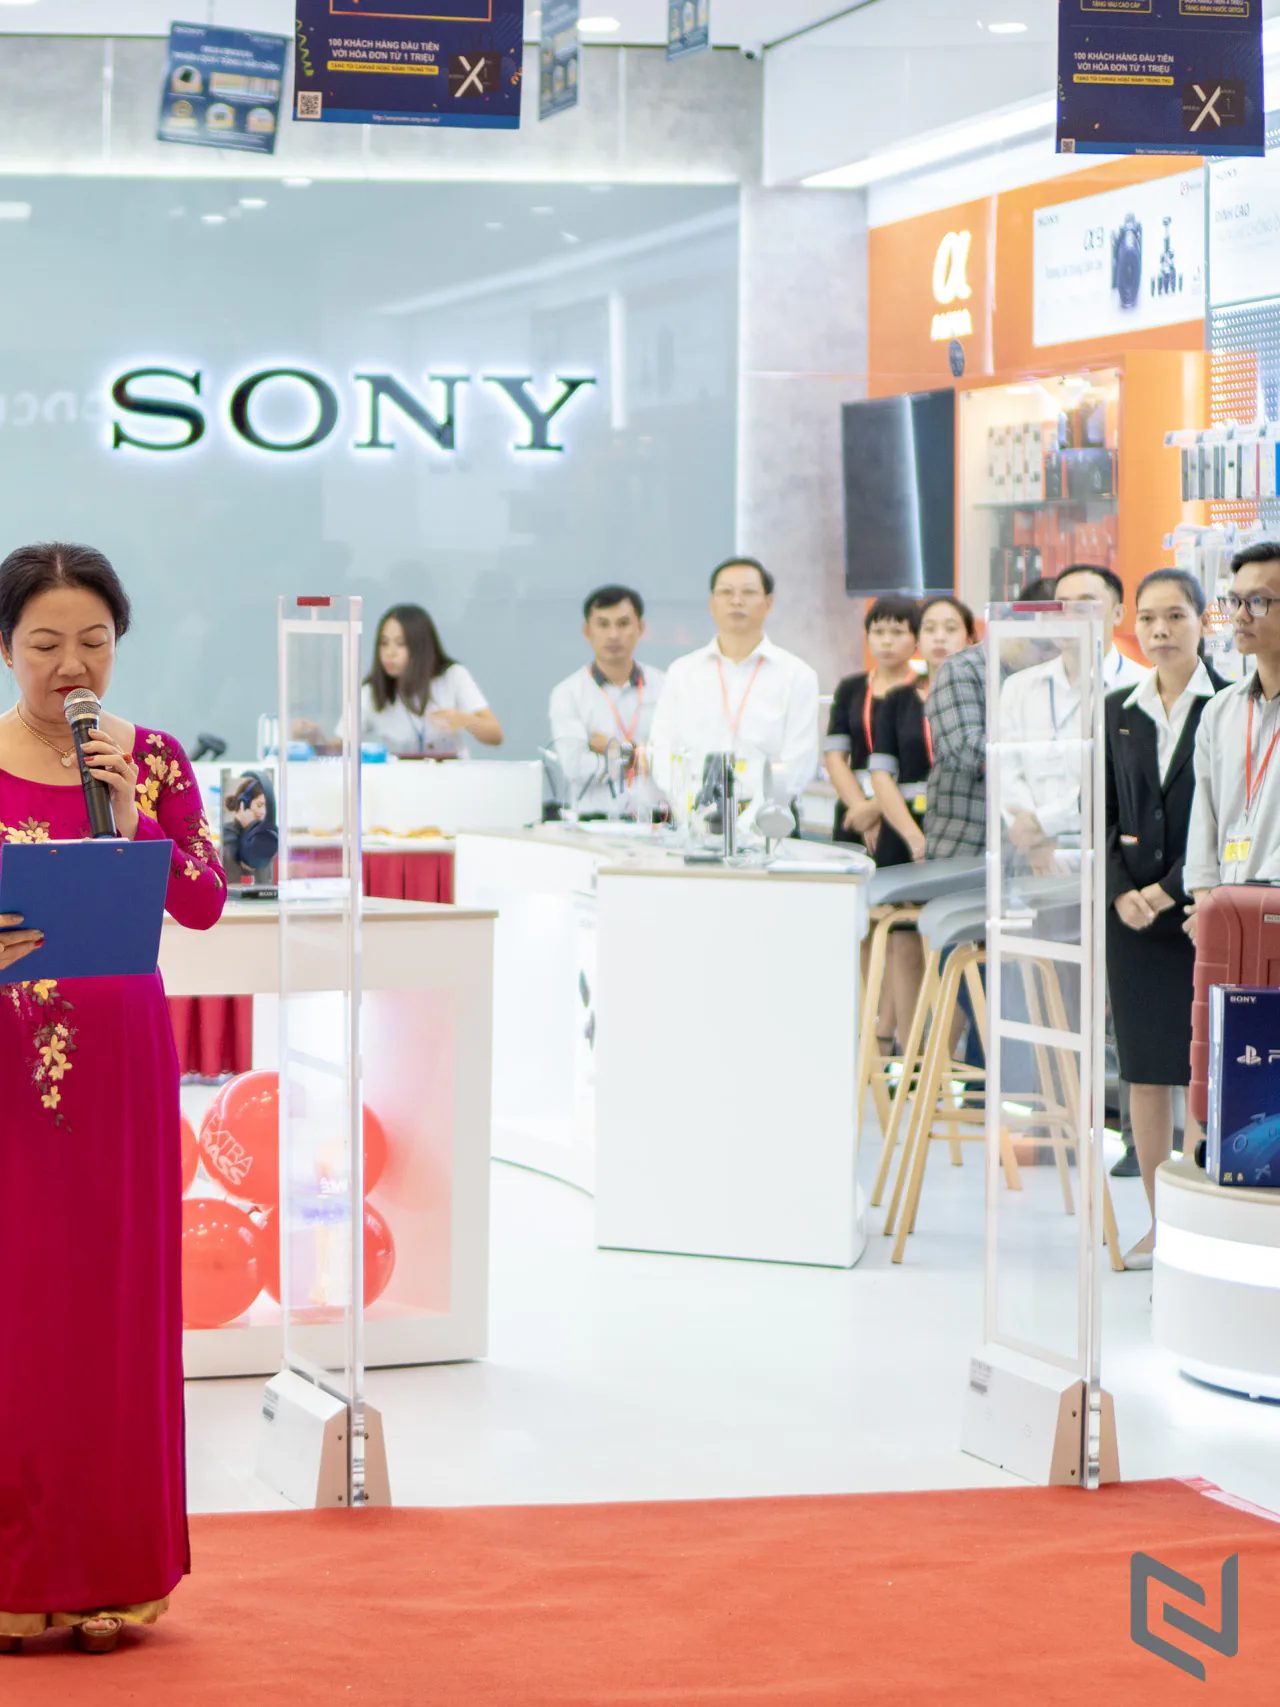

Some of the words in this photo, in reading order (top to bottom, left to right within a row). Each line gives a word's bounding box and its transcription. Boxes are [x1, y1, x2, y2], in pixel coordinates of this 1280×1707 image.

[328, 39, 342, 47] 100
[344, 38, 373, 48] KHÁCH
[375, 39, 399, 50] HÀNG
[420, 41, 439, 51] TIÊN
[1074, 52, 1086, 60] 100
[1088, 52, 1114, 60] KHÁCH
[1116, 53, 1137, 61] HÀNG
[1157, 53, 1174, 63] TIÊN
[111, 366, 598, 452] SONY
[1229, 995, 1257, 1004] SONY
[204, 1111, 254, 1176] EXTRA
